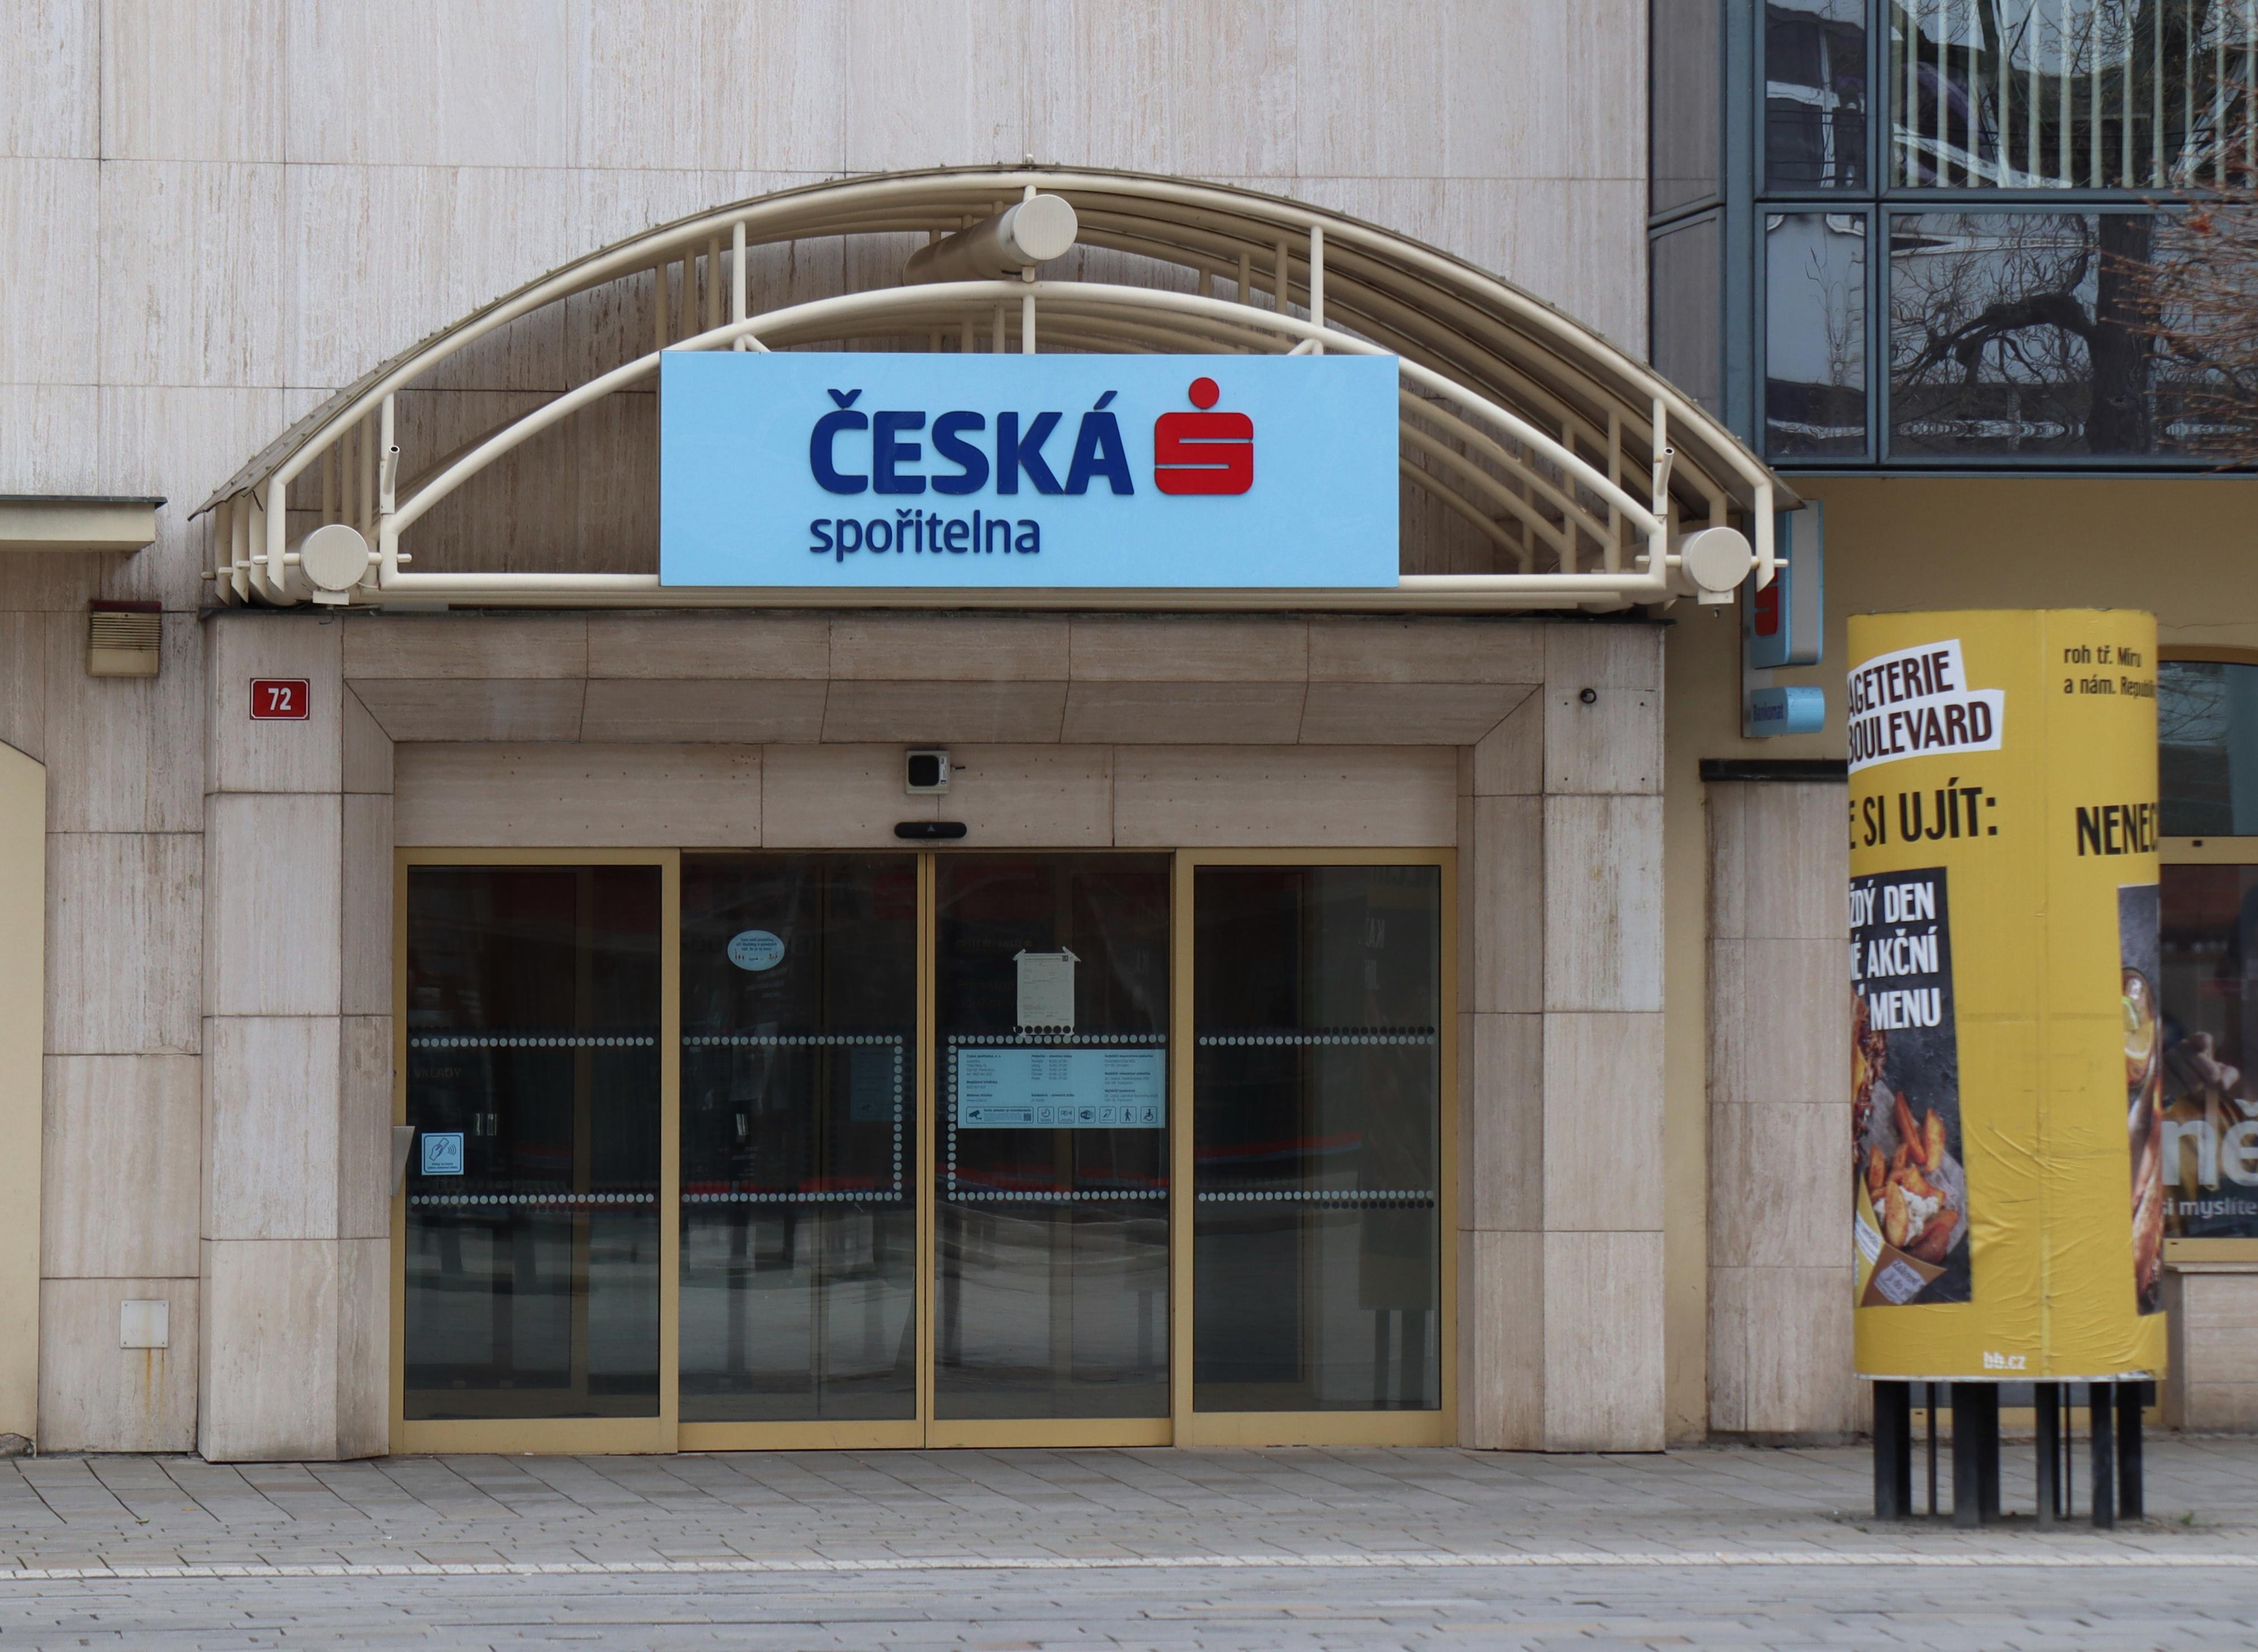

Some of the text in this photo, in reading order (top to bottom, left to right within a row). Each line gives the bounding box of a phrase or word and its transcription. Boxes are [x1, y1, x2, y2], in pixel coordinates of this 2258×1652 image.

[809, 388, 1135, 496] ČESKÁ
[809, 508, 1040, 562] spořitelna
[2064, 645, 2091, 664] roh
[2097, 645, 2113, 664] tř.
[268, 687, 292, 711] 72
[2064, 678, 2073, 694] a
[2080, 674, 2116, 694] nám.
[1863, 796, 1886, 847] SI
[1899, 777, 1998, 843] UJÍT:
[1884, 882, 1936, 923] DEN
[1867, 926, 1940, 979] AKČNÍ
[1870, 988, 1941, 1031] MENU
[2179, 1196, 2258, 1219] myslíte
[1983, 1349, 2027, 1370] bb.cz
